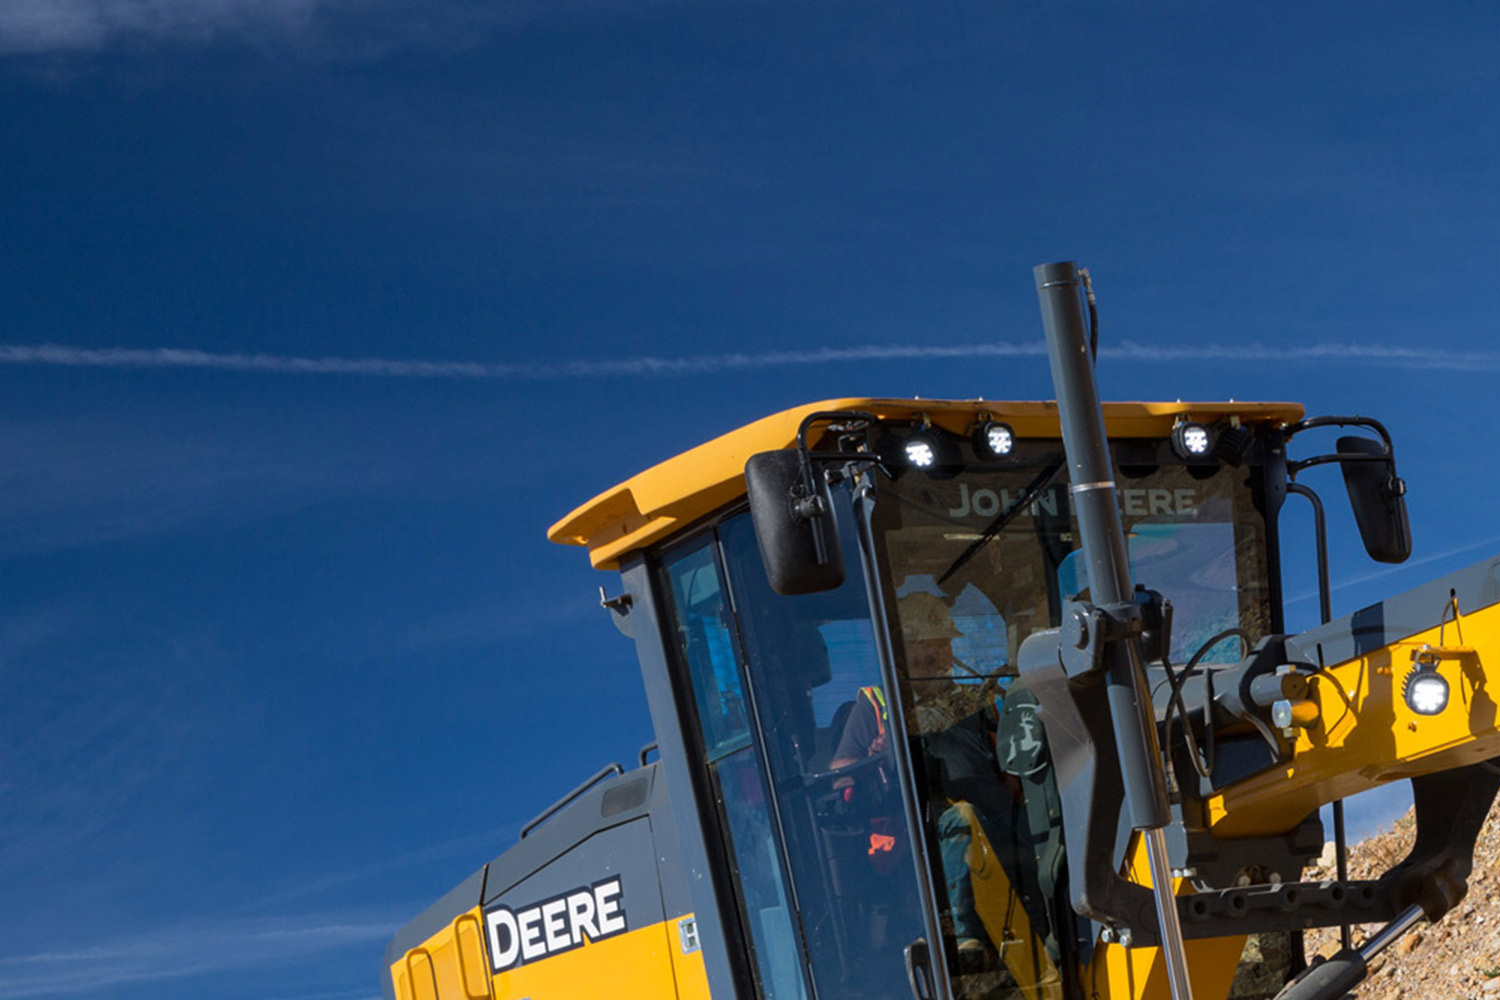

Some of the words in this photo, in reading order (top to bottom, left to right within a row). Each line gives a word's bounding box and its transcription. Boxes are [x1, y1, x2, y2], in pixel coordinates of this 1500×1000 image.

[949, 483, 1058, 517] JOHN
[1070, 488, 1197, 515] ERE
[486, 879, 626, 970] DEERE
